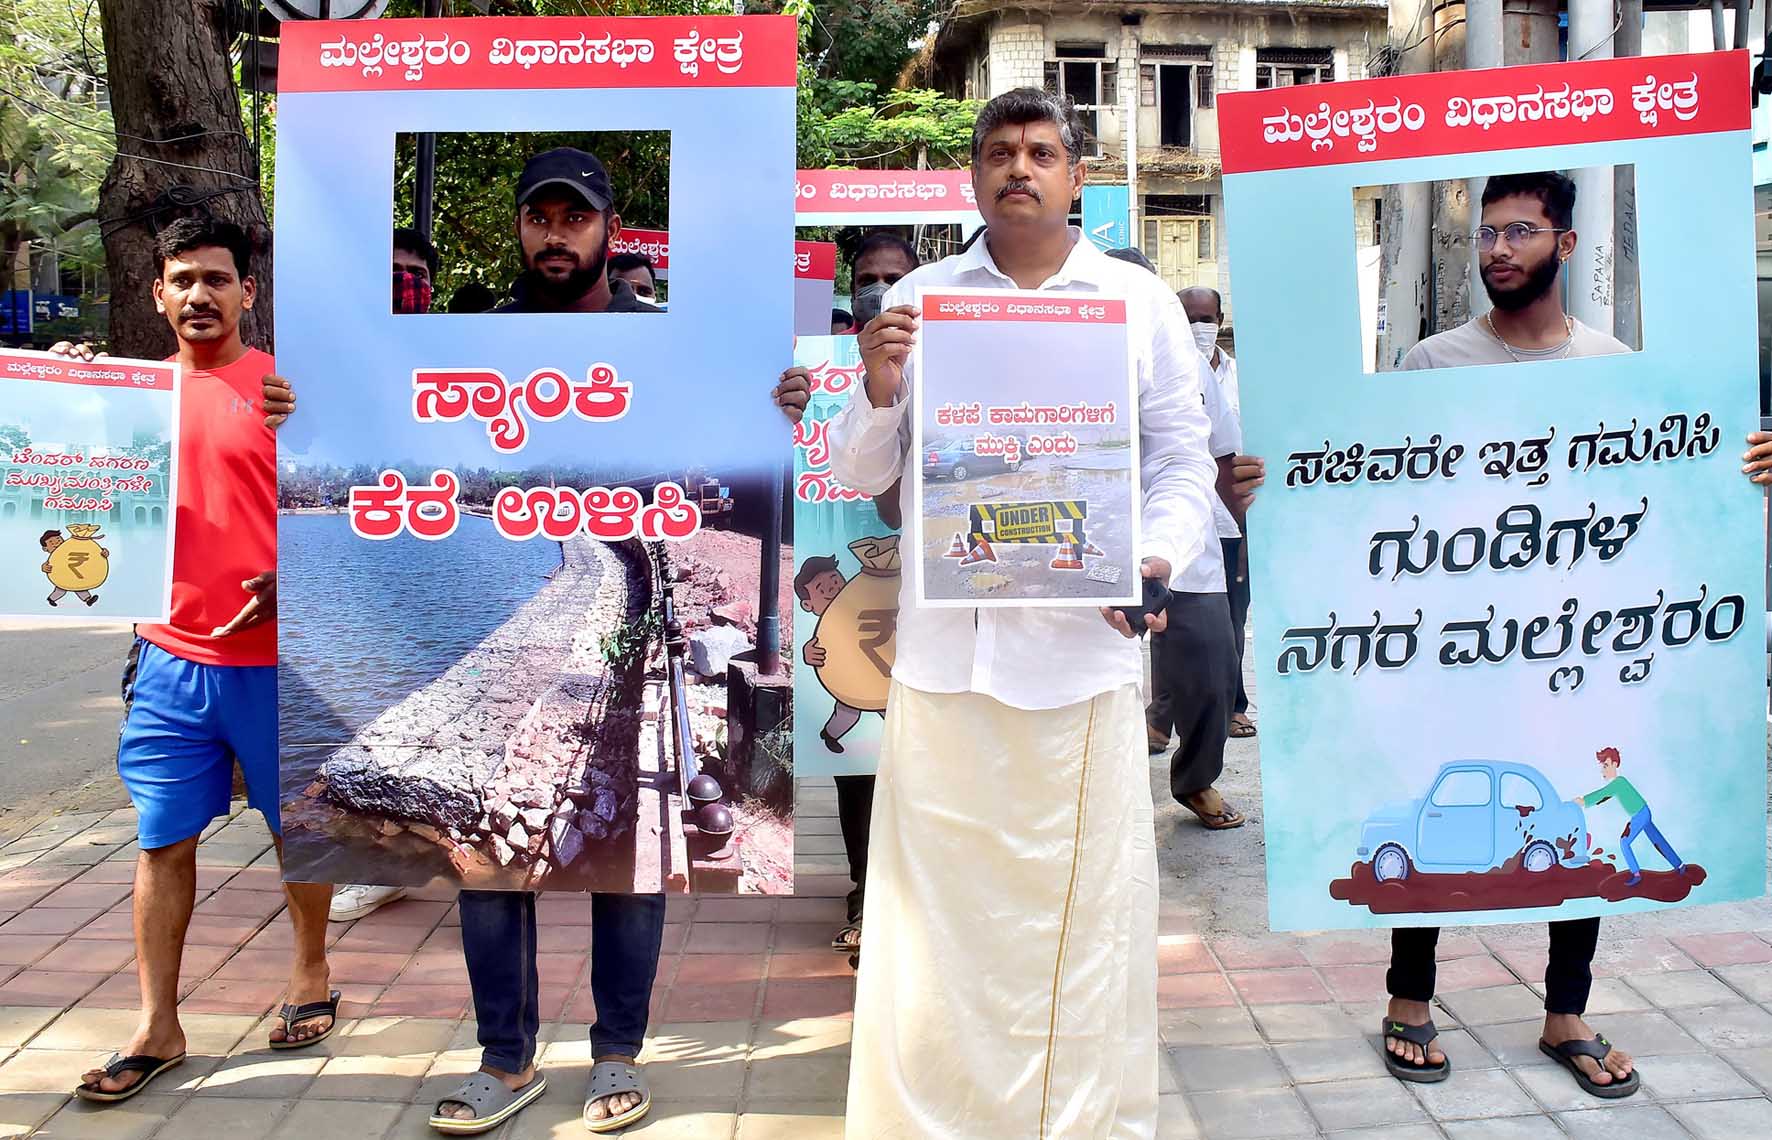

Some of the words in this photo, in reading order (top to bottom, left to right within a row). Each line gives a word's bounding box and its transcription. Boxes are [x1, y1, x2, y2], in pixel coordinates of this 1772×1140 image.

[320, 33, 471, 82] ಮಲ್ಲೇಶ್ವರಂ
[488, 31, 655, 70] ವಿಧಾನಸಭಾ
[673, 26, 744, 78] ಕ್ಷೇತ್ರ
[1262, 95, 1425, 153] ಮಲ್ಲೇಶ್ವರಂ
[1445, 82, 1614, 131] ವಿಧಾನಸಭಾ
[1631, 72, 1700, 127] ಕ್ಷೇತ್ರ
[829, 180, 947, 202] ವಿಧಾನಸಭಾ
[939, 302, 1000, 319] ಮಲ್ಲೇಶ್ವರಂ
[1006, 303, 1072, 315] ವಿಧಾನಸಭಾ
[1078, 304, 1105, 320] ಕ್ಷೇತ್ರ
[7, 362, 62, 378] ಮಲ್ಲೇಶ್ವರಂ
[68, 368, 126, 381] ವಿಧಾನಸಭಾ
[131, 371, 156, 385] ಕ್ಷೇತ್ರ
[415, 366, 630, 450] ಸ್ಯಾಂಕಿ
[937, 404, 980, 424] ಕಳಪೆ
[989, 403, 1115, 424] ಕಾಮಗಾರಿಗಳಿಗೆ
[12, 448, 84, 466] ಟೆಂಡರ್
[88, 456, 150, 471] ಹಗರಣ
[975, 434, 1020, 461] ಮುಕ್ತಿ
[1286, 434, 1465, 487] ಸಚಿವರೇ
[1478, 426, 1555, 487] ಇತ್ತ
[1568, 412, 1721, 473] ಗಮನಿಸಿ
[44, 495, 113, 511] ಗಮನಿಸಿ
[352, 473, 457, 537] ಕೆರೆ
[497, 486, 698, 538] ಉಳಿಸಿ
[1000, 506, 1049, 527] UNDER
[1000, 525, 1051, 537] CONSTRUCTION
[1368, 496, 1648, 583] ಗುಂಡಿಗಳ
[1276, 608, 1424, 677] ನಗರ
[1438, 584, 1746, 694] ಮಲ್ಲೇಶ್ವರಂ
